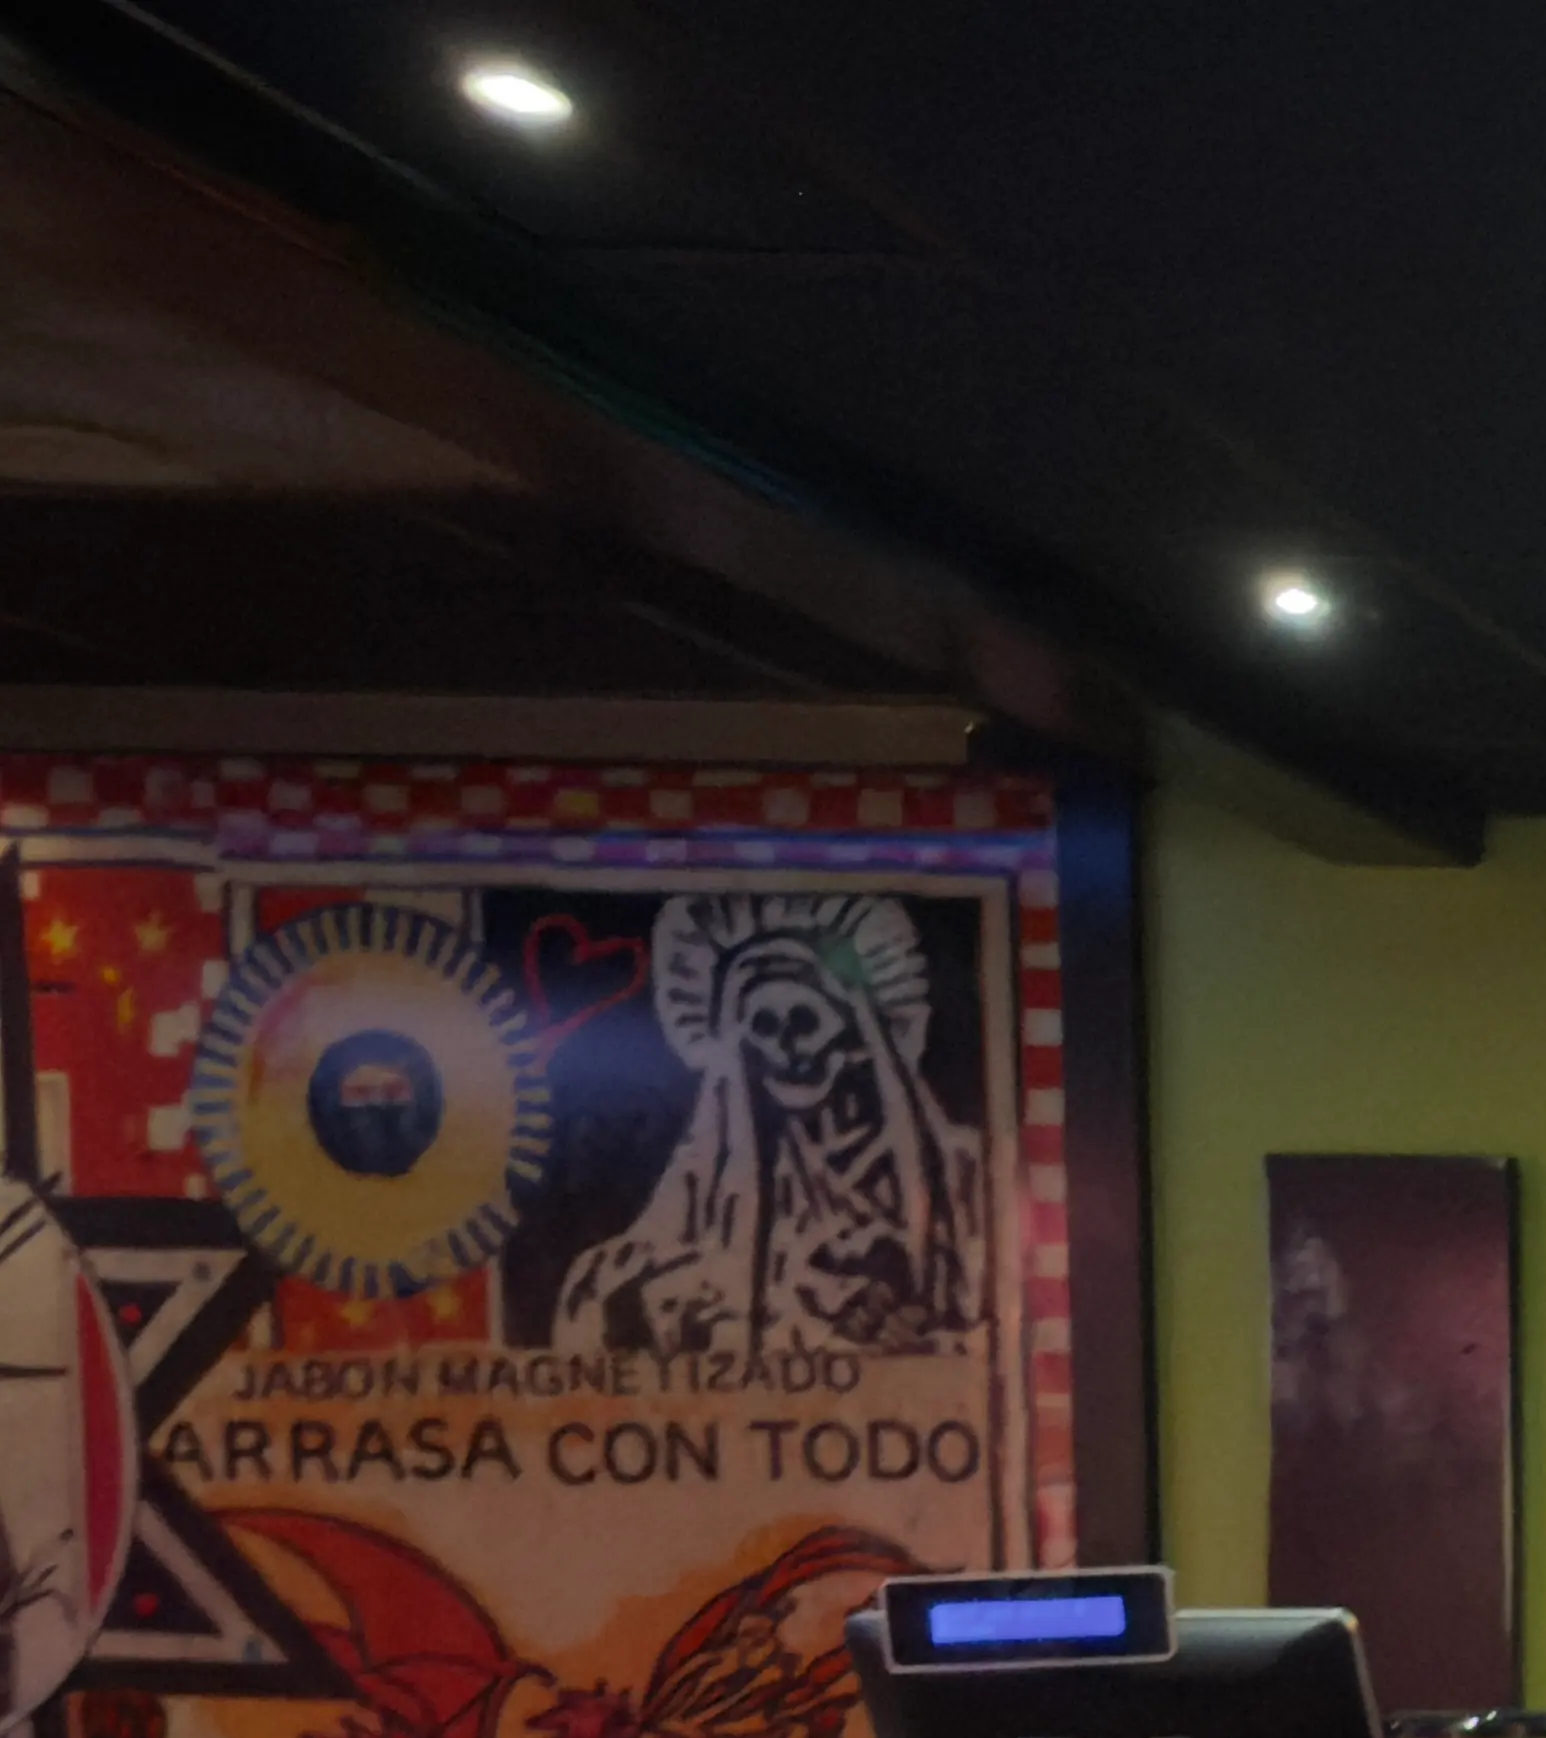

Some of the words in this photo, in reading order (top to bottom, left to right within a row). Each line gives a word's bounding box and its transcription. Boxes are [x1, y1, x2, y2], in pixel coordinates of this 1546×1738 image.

[231, 1355, 421, 1400] JABON
[164, 1416, 523, 1484] ARRASA
[547, 1420, 720, 1485] CON
[749, 1418, 980, 1485] TODO
